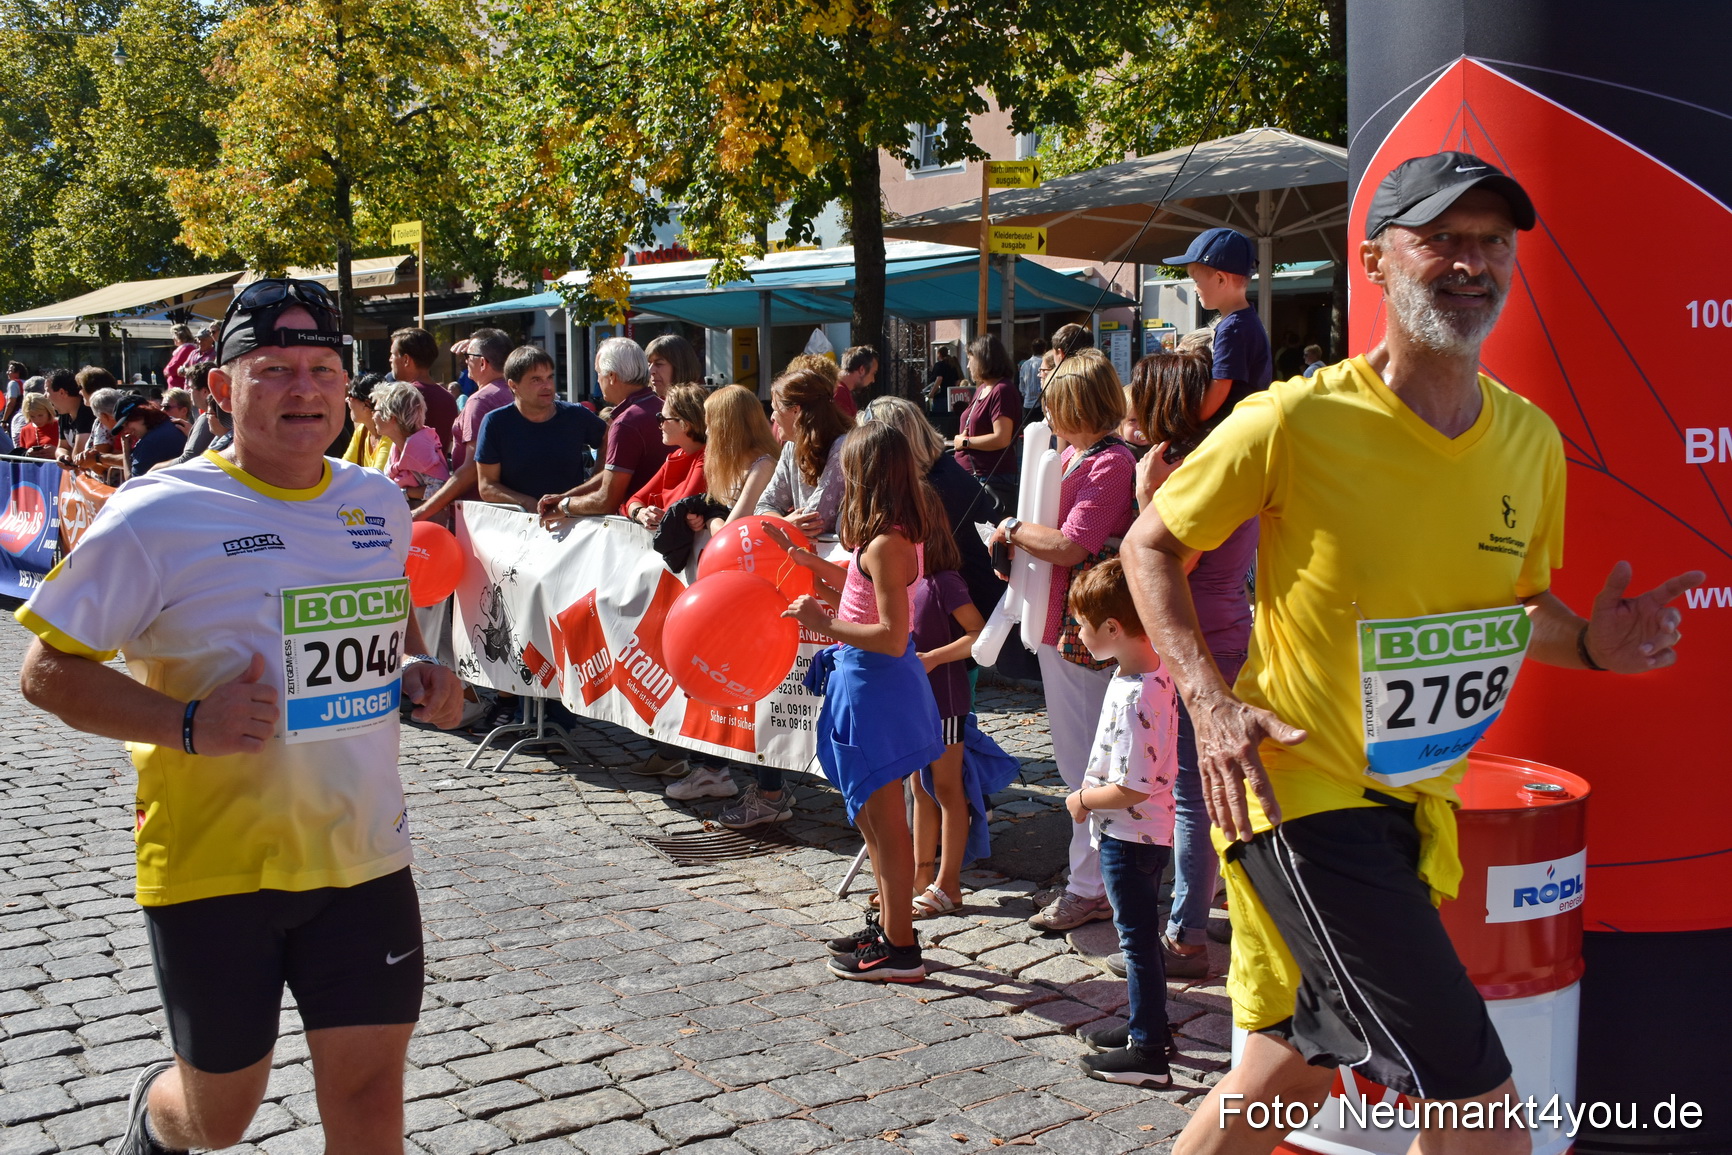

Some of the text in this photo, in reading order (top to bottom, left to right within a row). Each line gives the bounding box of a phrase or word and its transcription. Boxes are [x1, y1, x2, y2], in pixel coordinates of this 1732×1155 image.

[996, 176, 1021, 187] ausgabe
[397, 229, 420, 239] Toiletten
[994, 231, 1034, 240] Kleiderbeutel-
[1001, 241, 1026, 250] ausgabe
[297, 332, 340, 344] Kalenji
[339, 508, 366, 526] 20
[223, 534, 284, 552] BOCK
[297, 586, 406, 626] BOCK
[1377, 615, 1519, 663] BOCK
[304, 630, 399, 688] 2048
[573, 647, 611, 688] Braun
[614, 633, 674, 700] Braun
[320, 690, 392, 721] JÜRGEN
[626, 678, 660, 714] Sicher ist sicher
[1386, 665, 1509, 730] 2768
[770, 702, 785, 714] Tel.
[787, 704, 812, 717] 09181
[710, 709, 756, 731] Sicher ist sicher
[771, 716, 812, 732] Fax 09181
